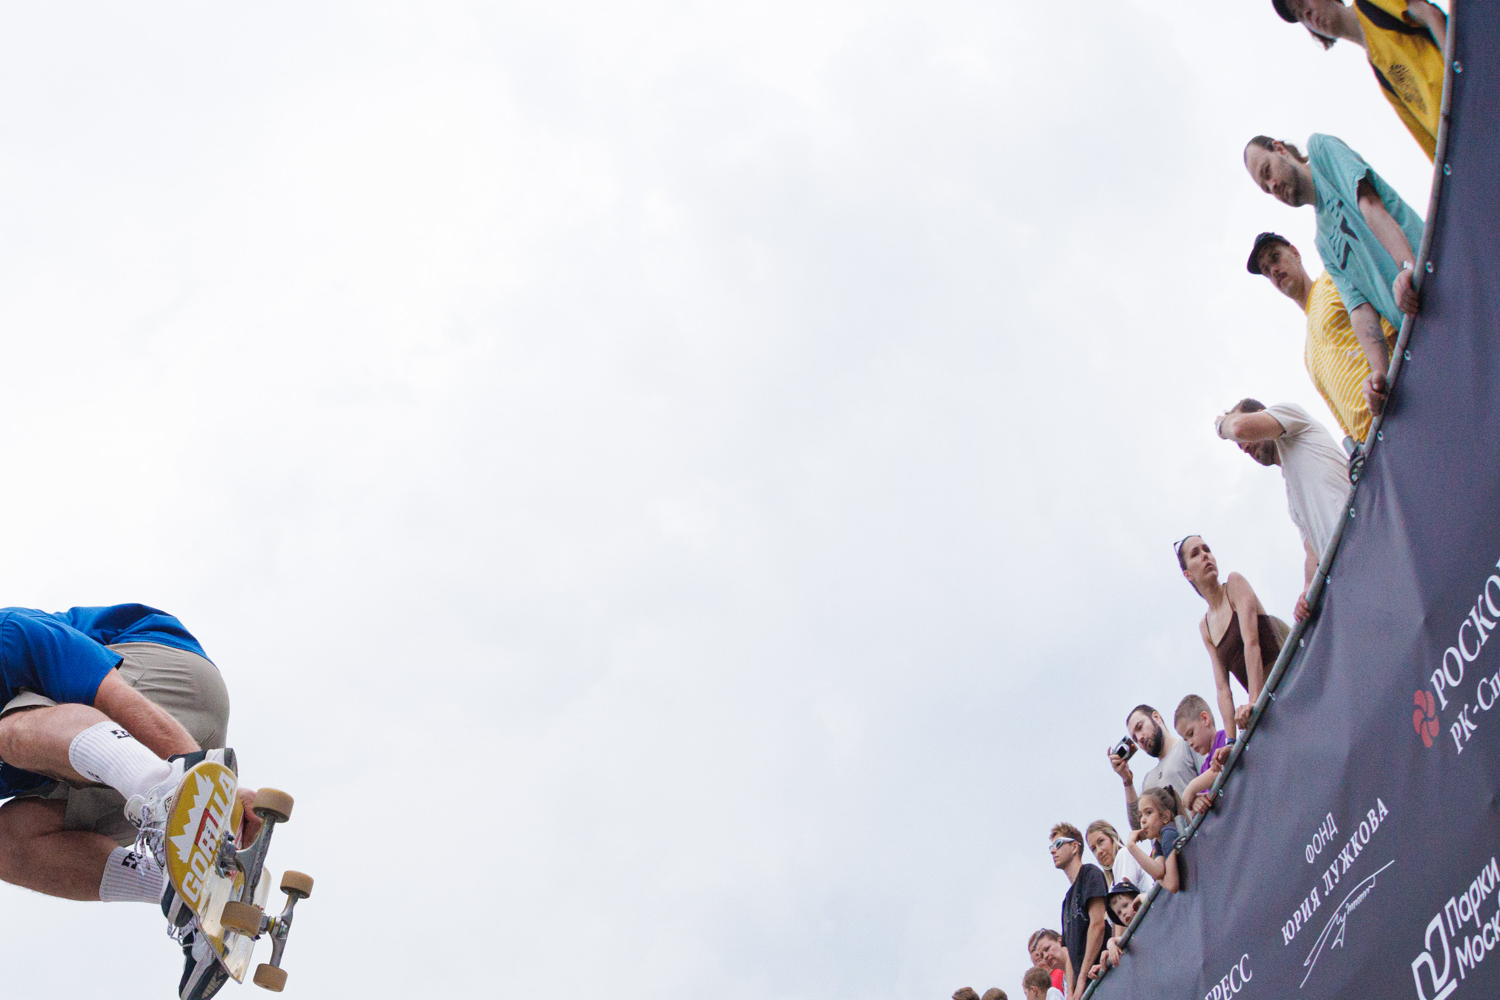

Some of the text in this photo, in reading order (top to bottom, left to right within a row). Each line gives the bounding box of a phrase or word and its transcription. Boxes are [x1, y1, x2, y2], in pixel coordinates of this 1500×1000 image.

[1430, 556, 1500, 712] РОСКО
[181, 770, 236, 903] GORILLA
[1281, 887, 1322, 946] ЮРИЯ
[1322, 797, 1389, 896] ЛУЖКОВА
[1305, 812, 1339, 864] ФОНД
[1444, 856, 1500, 937] Парки
